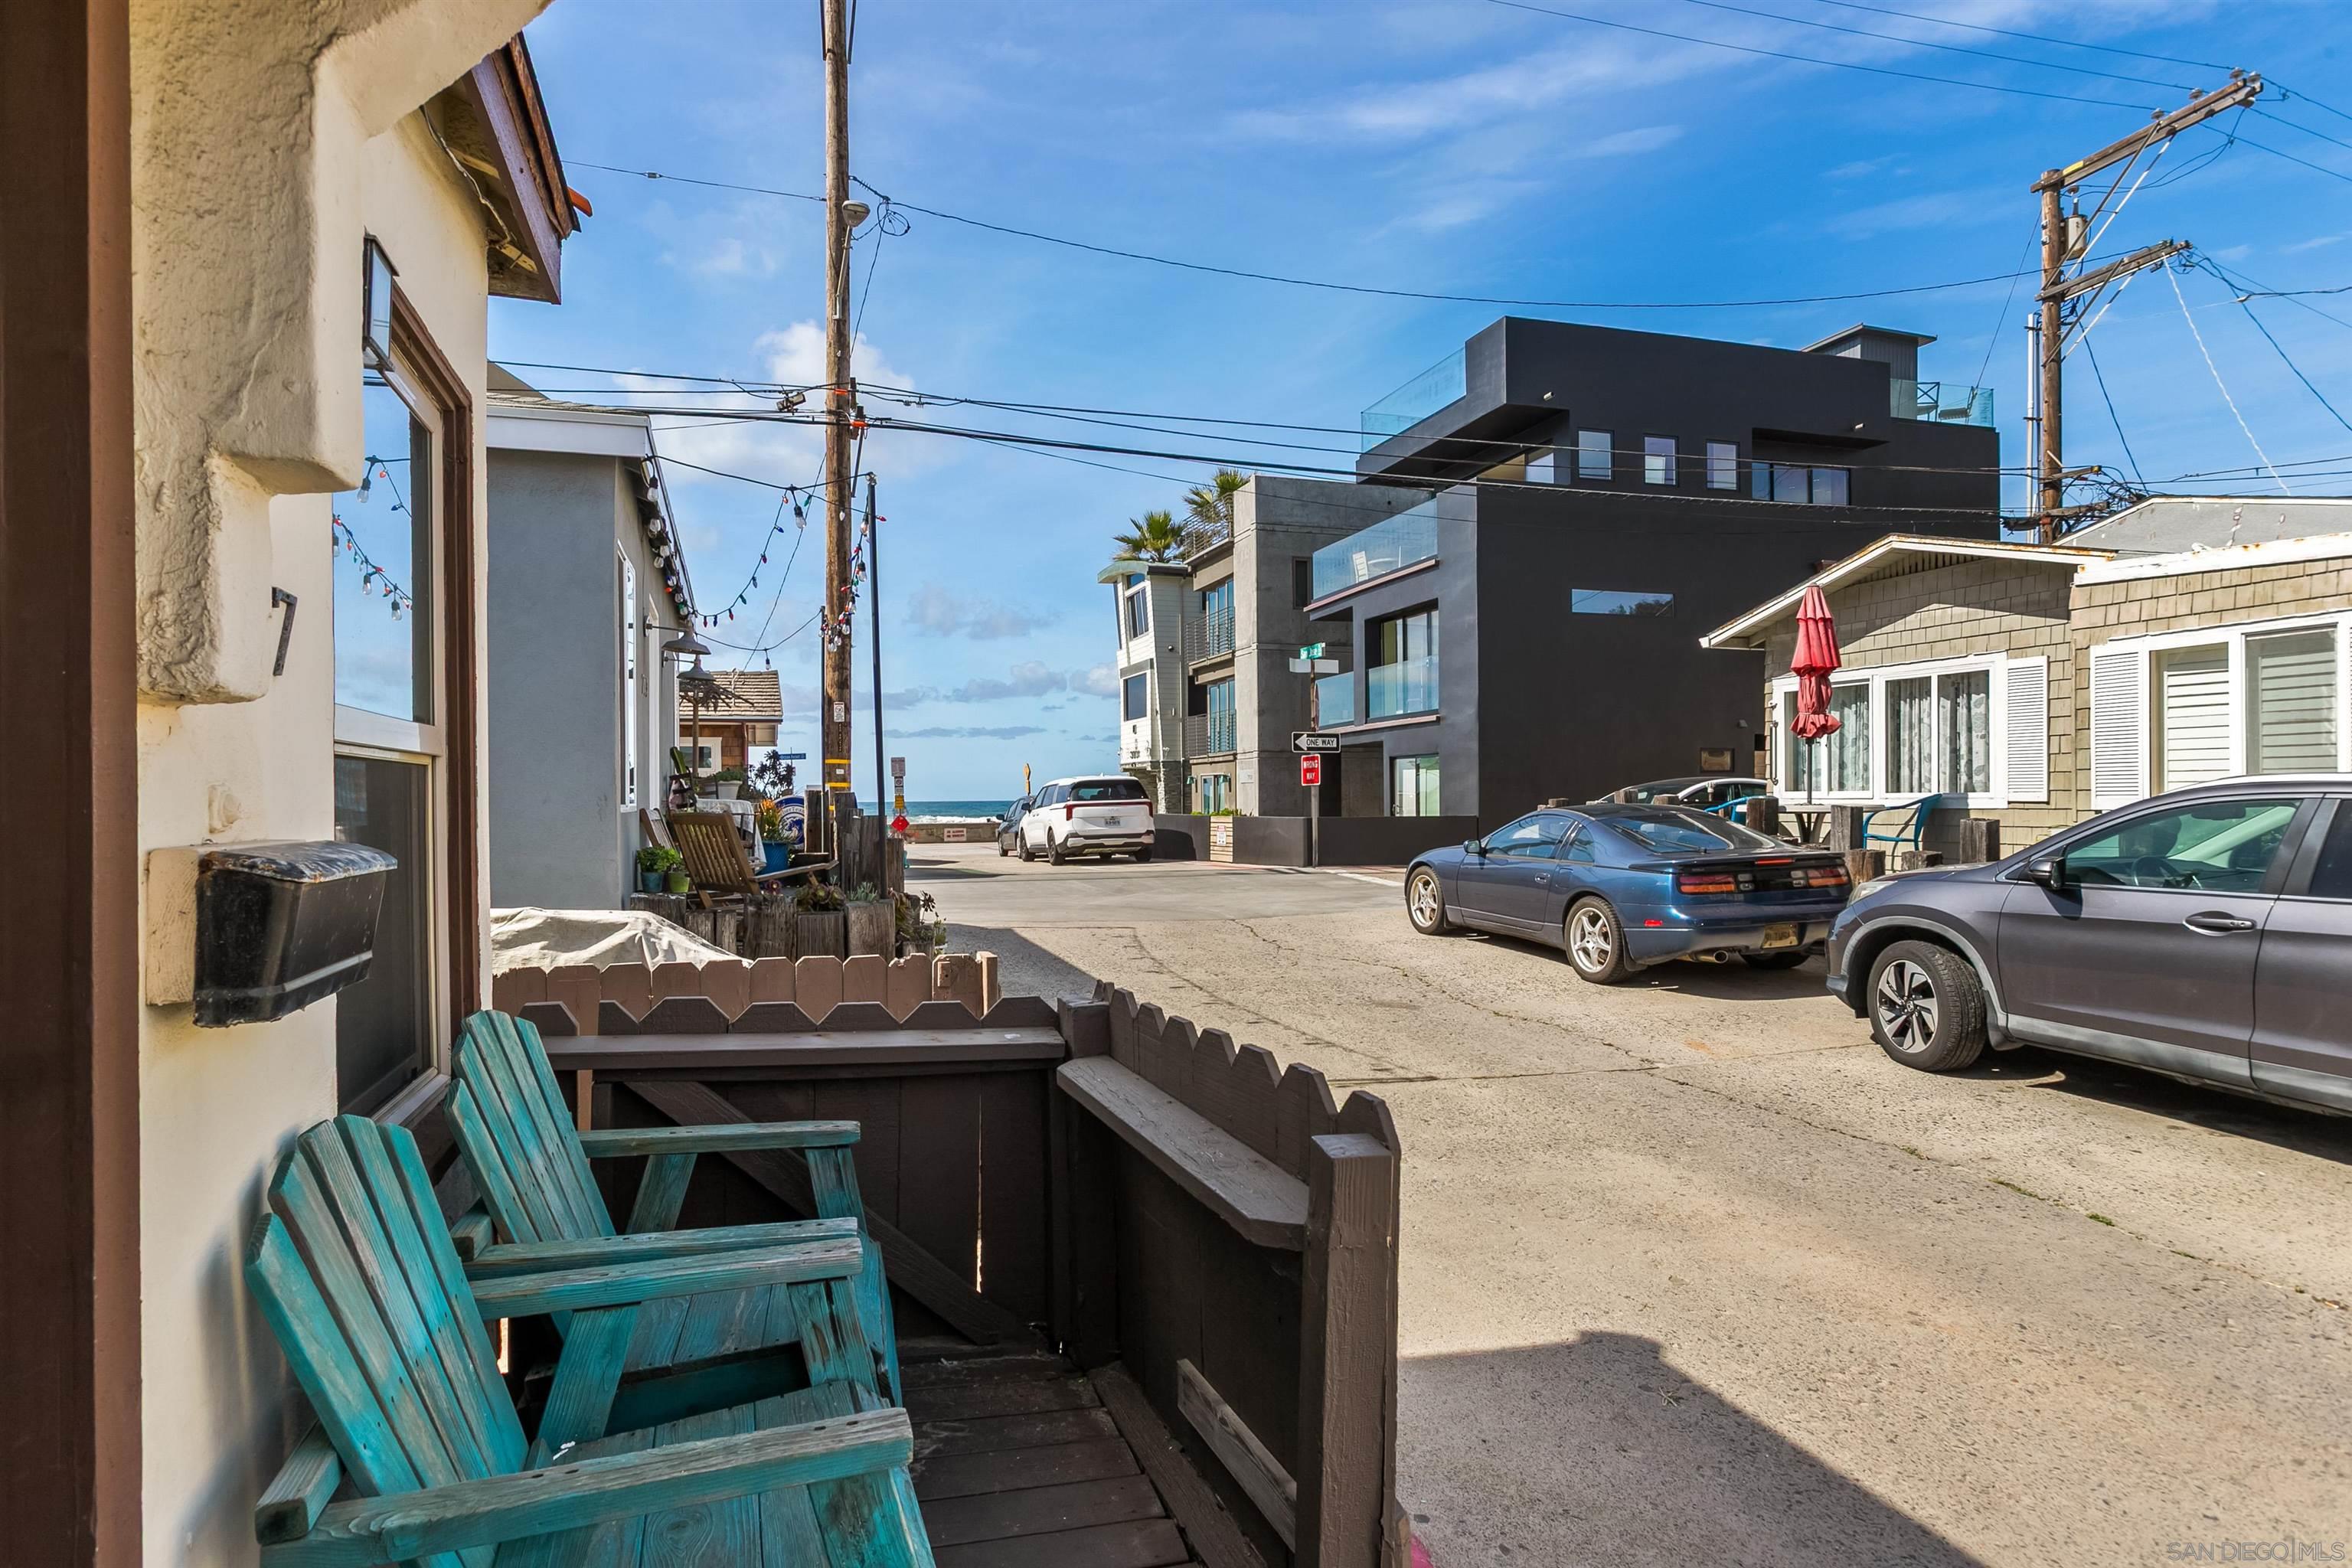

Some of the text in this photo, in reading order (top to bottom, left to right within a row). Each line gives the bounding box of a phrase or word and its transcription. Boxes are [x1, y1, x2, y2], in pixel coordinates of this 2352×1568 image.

[272, 586, 298, 676] 7
[1303, 760, 1318, 769] WRONG
[1306, 772, 1315, 780] WAY
